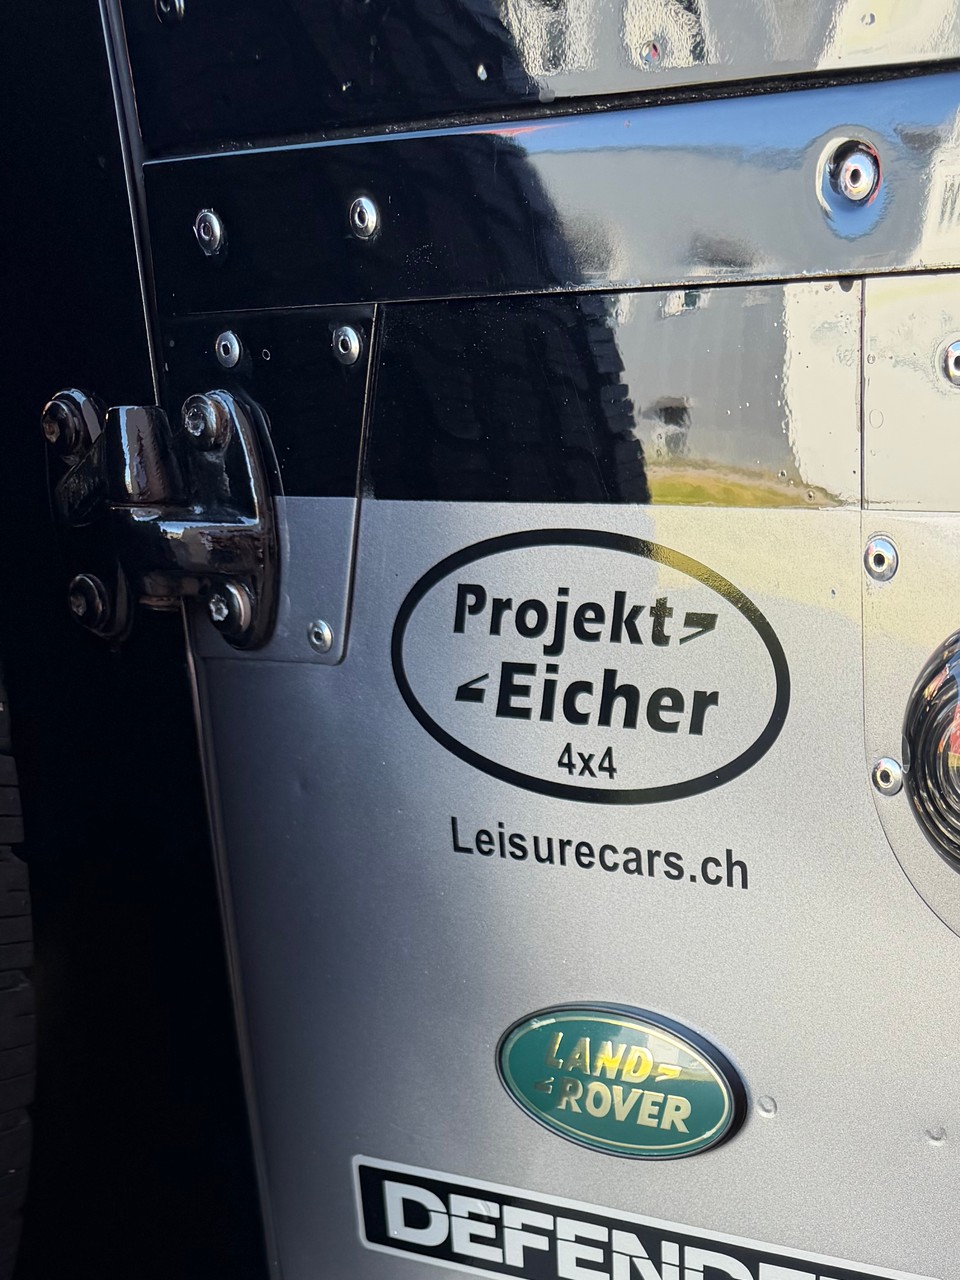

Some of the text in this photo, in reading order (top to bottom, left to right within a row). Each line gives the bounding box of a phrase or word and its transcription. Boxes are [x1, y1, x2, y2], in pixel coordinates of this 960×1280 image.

[453, 583, 673, 656] Projekt
[496, 661, 719, 735] Eicher
[557, 742, 617, 779] 4x4
[451, 816, 748, 889] Leisurecars.ch
[545, 1031, 654, 1083] LAND
[557, 1077, 691, 1134] ROVER
